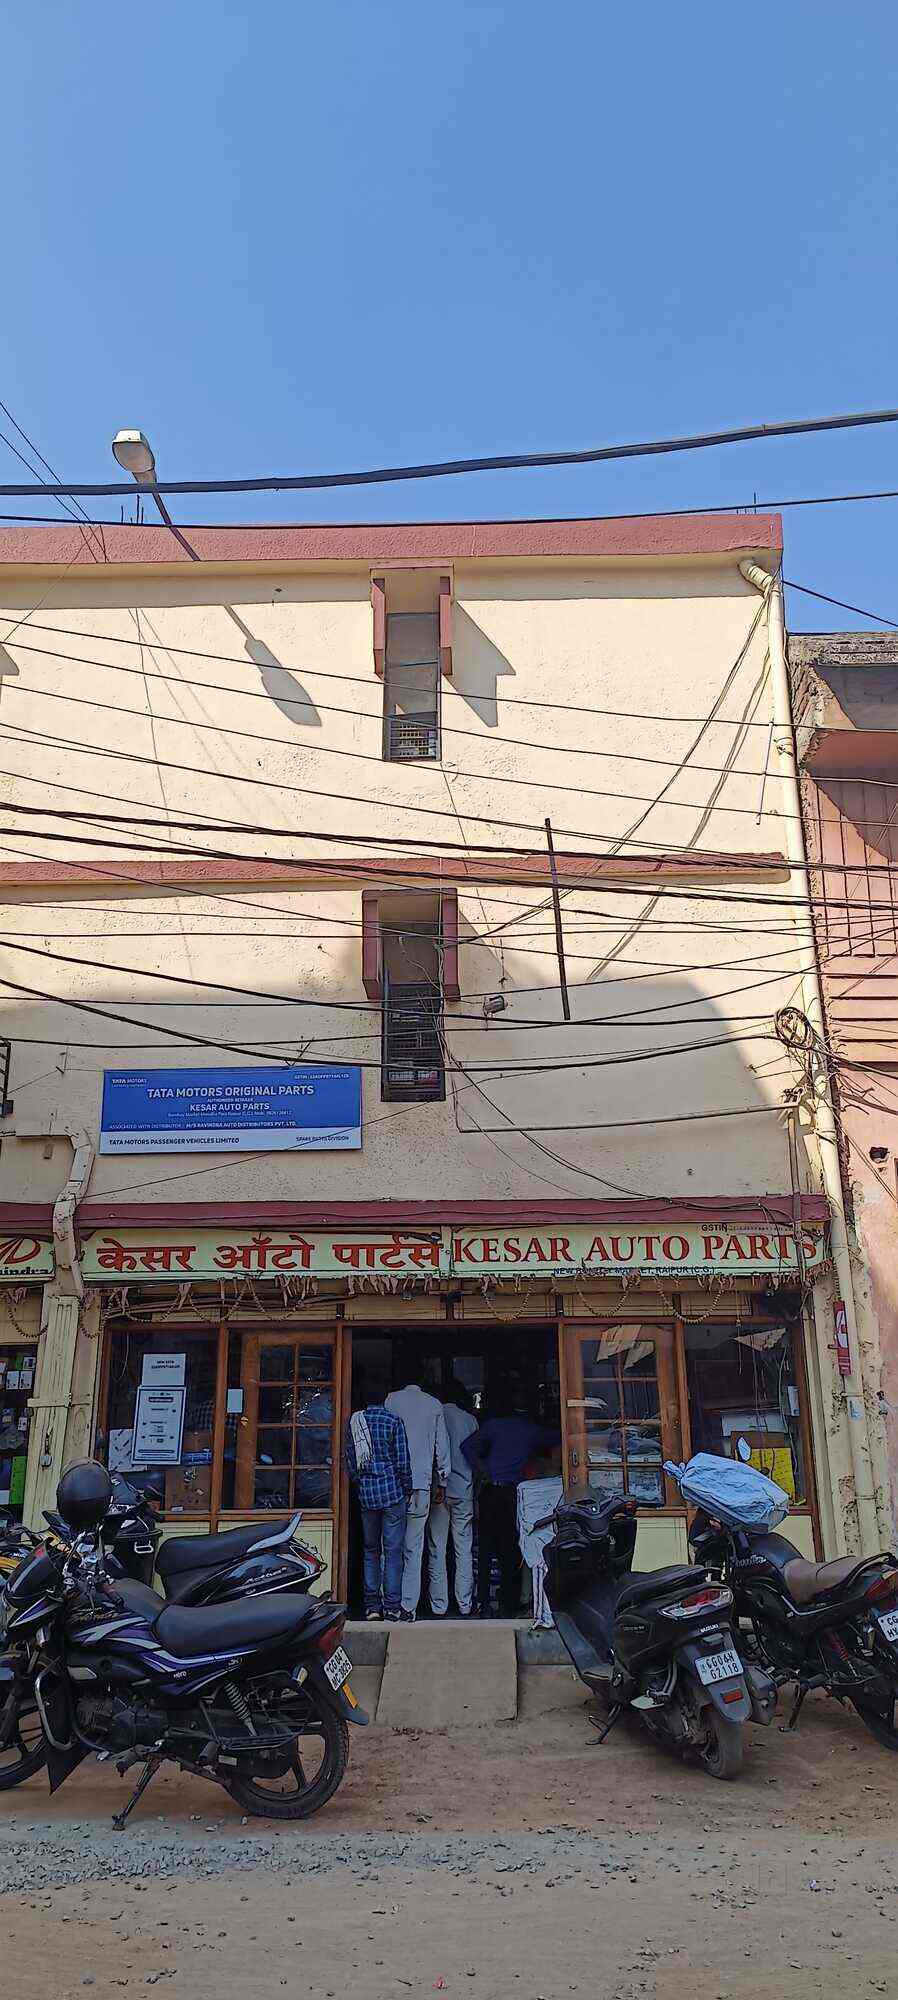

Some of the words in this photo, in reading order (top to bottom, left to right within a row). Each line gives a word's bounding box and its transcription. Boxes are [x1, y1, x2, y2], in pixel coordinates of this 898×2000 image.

[147, 1088, 174, 1098] TATA
[176, 1087, 222, 1097] MOTORS
[225, 1086, 277, 1096] ORIGINAL
[279, 1085, 315, 1095] PARTS
[190, 1104, 217, 1112] KESAR
[218, 1103, 242, 1111] AUTO
[243, 1102, 270, 1110] PARTS
[96, 1237, 196, 1272] केसर
[453, 1236, 576, 1263] KESAR
[584, 1235, 690, 1262] AUTO
[701, 1233, 818, 1260] PARTS
